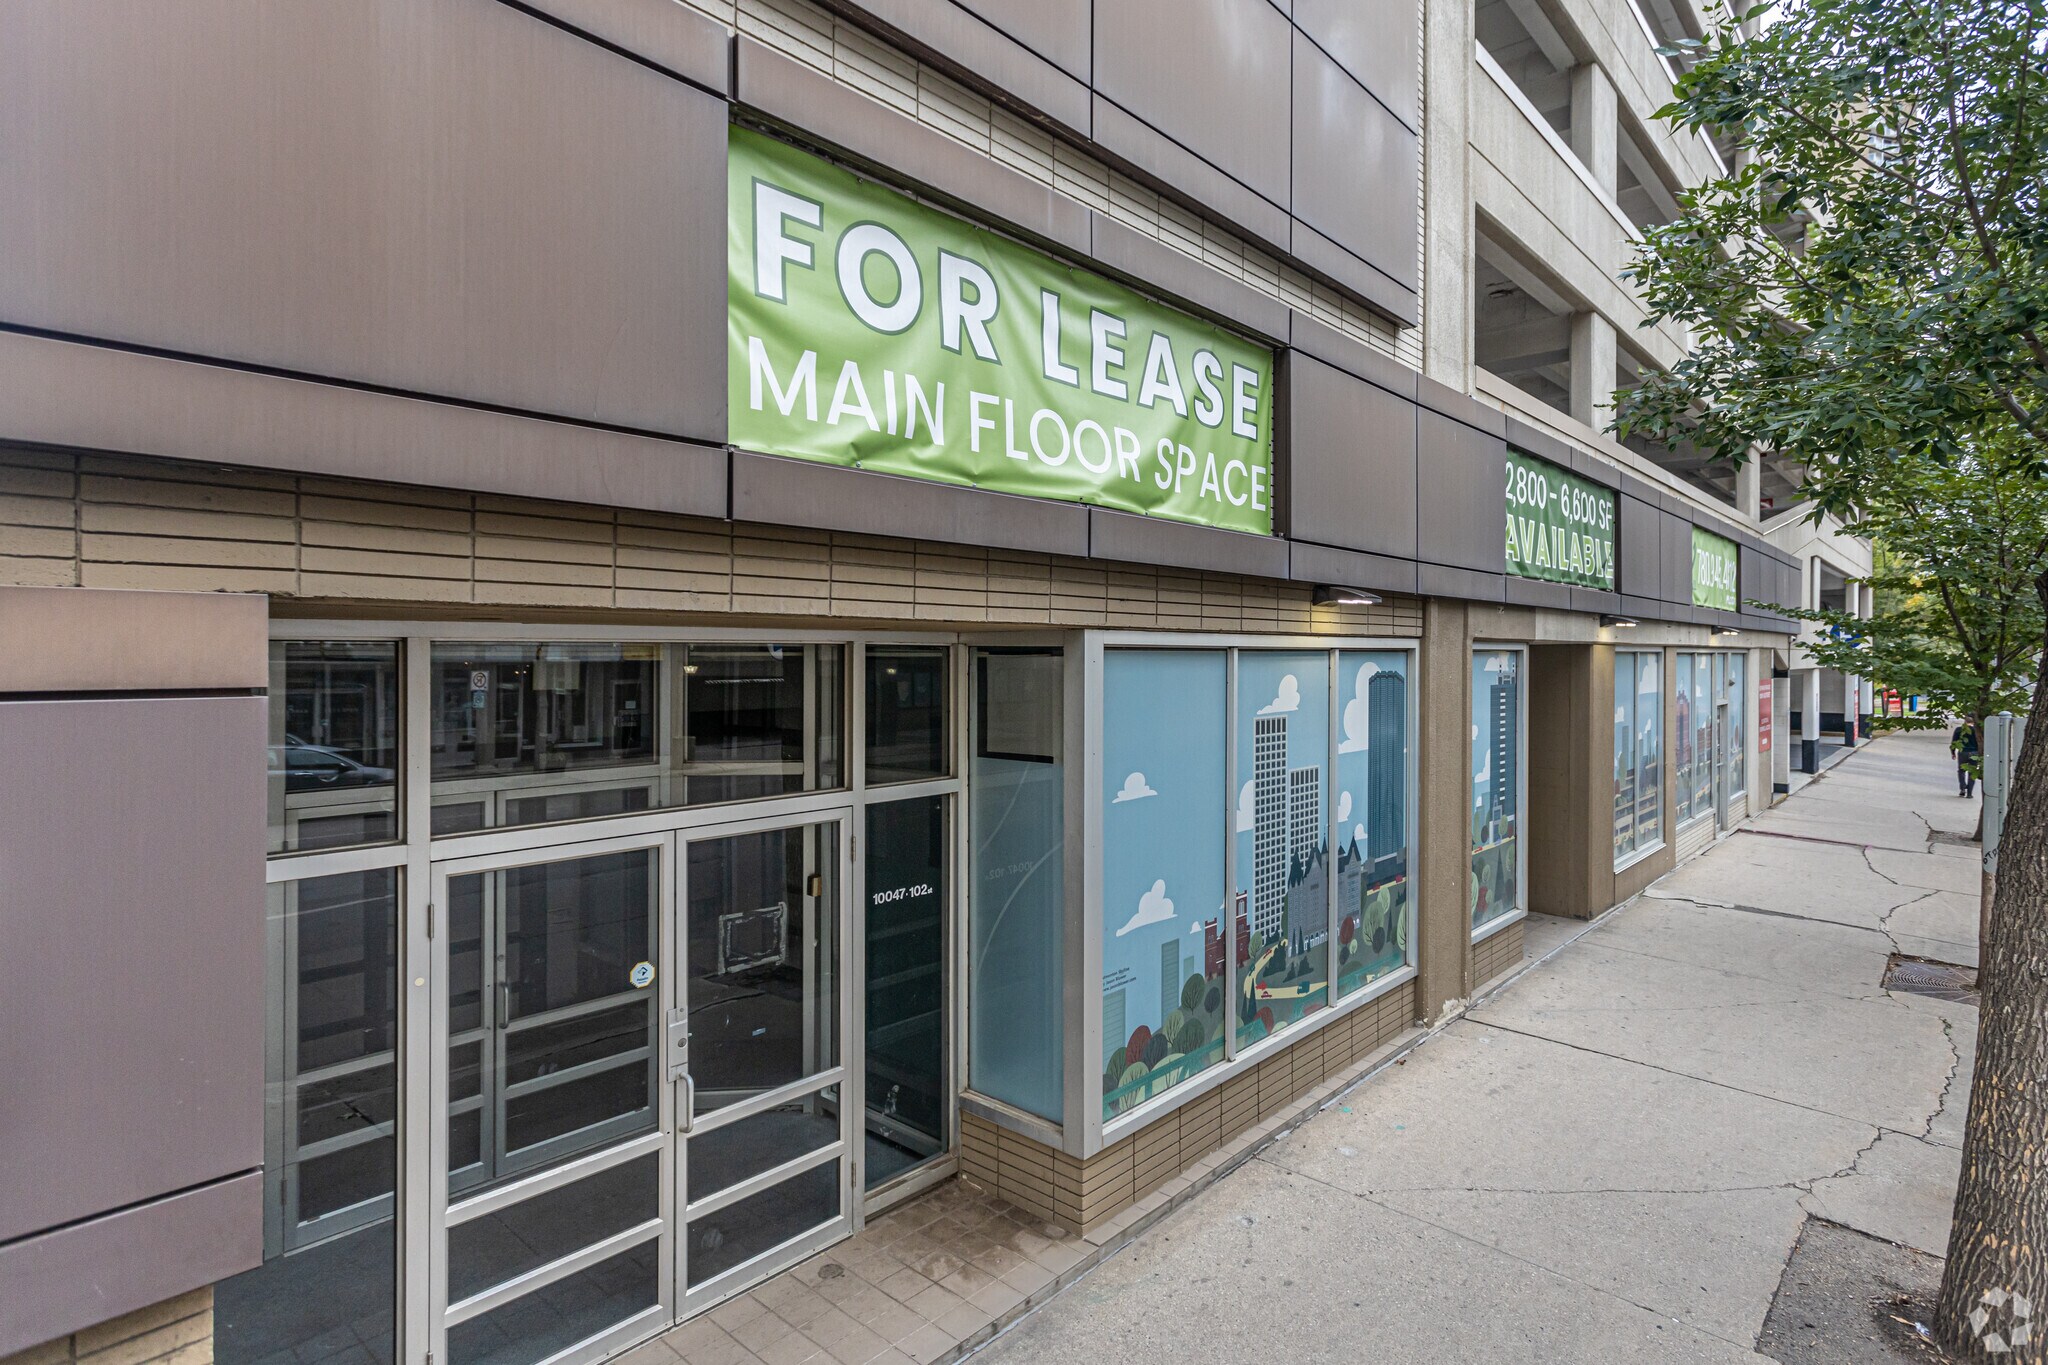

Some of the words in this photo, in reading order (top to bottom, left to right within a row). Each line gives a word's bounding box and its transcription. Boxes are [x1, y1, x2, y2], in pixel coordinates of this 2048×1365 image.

[752, 176, 1002, 366] FOR
[1040, 287, 1259, 442] LEASE
[748, 335, 945, 446] MAIN
[969, 390, 1140, 483] FLOOR
[1154, 437, 1266, 512] SPACE
[1505, 461, 1547, 509] 2,800
[1561, 483, 1596, 526] 6,600
[1598, 498, 1612, 531] SF
[1505, 513, 1614, 579] AVAILABLE
